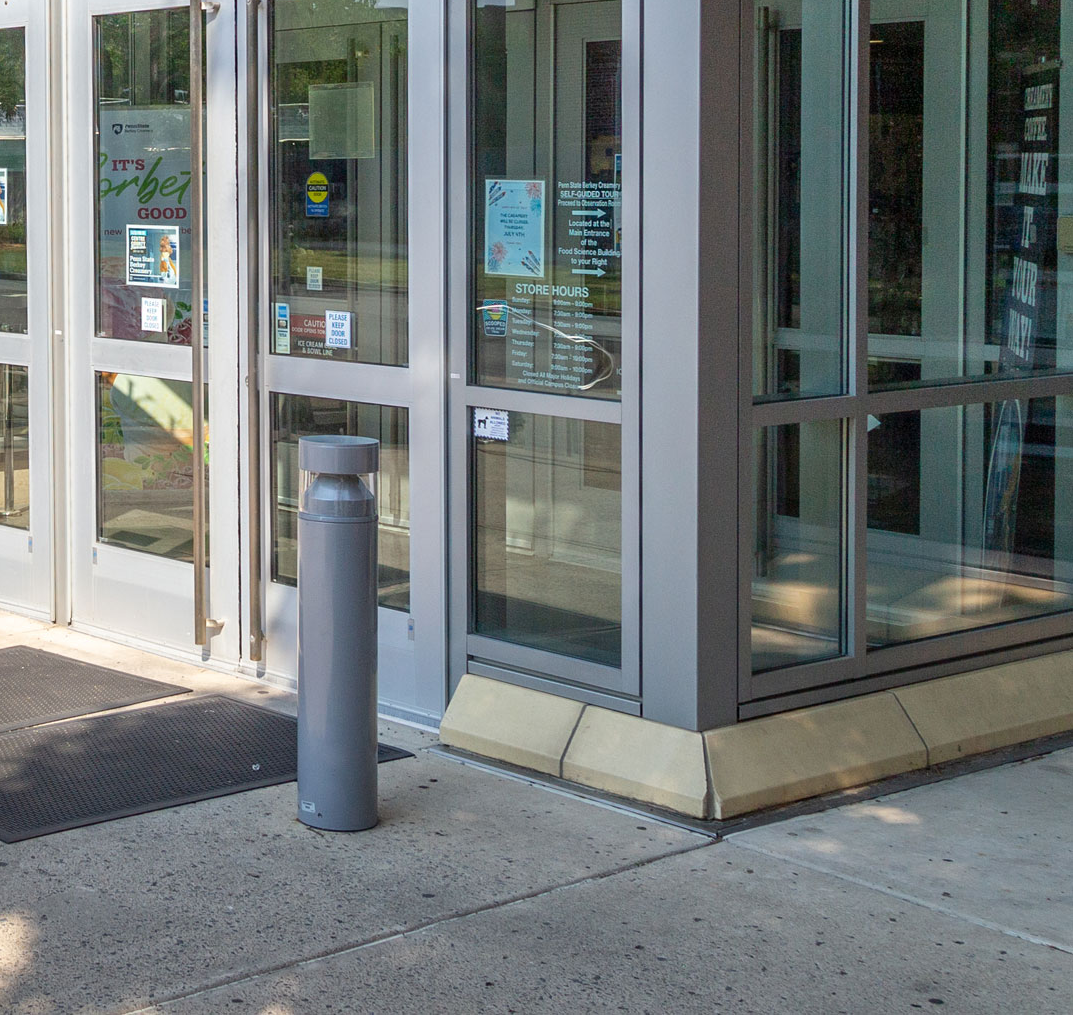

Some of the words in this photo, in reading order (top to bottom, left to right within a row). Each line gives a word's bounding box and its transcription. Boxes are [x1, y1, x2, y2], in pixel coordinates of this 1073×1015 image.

[112, 159, 145, 171] IT'S
[1019, 152, 1049, 195] MAKE
[582, 182, 598, 190] Berkey
[598, 182, 621, 190] Creamery
[560, 190, 600, 198] SELF-GUIDED
[601, 190, 619, 198] TOUR
[581, 199, 608, 207] Observation
[137, 207, 187, 219] GOOD
[583, 229, 610, 237] Entrance
[580, 238, 587, 246] of
[558, 247, 573, 255] Food
[574, 247, 596, 255] Science
[597, 248, 621, 258] Building
[591, 258, 608, 266] Right
[1011, 256, 1037, 306] YOUR
[515, 283, 550, 296] STORE
[552, 286, 589, 298] HOURS
[328, 313, 347, 322] PLEASE
[304, 319, 326, 328] CAUTIO
[331, 329, 345, 337] DOOR
[328, 337, 348, 346] CLOSED
[511, 339, 534, 347] Thursday:
[307, 347, 322, 355] BOWL
[522, 370, 539, 378] Closed
[546, 372, 561, 380] Major
[561, 373, 581, 382] Holidays
[526, 378, 544, 386] Official
[544, 380, 564, 388] Campus
